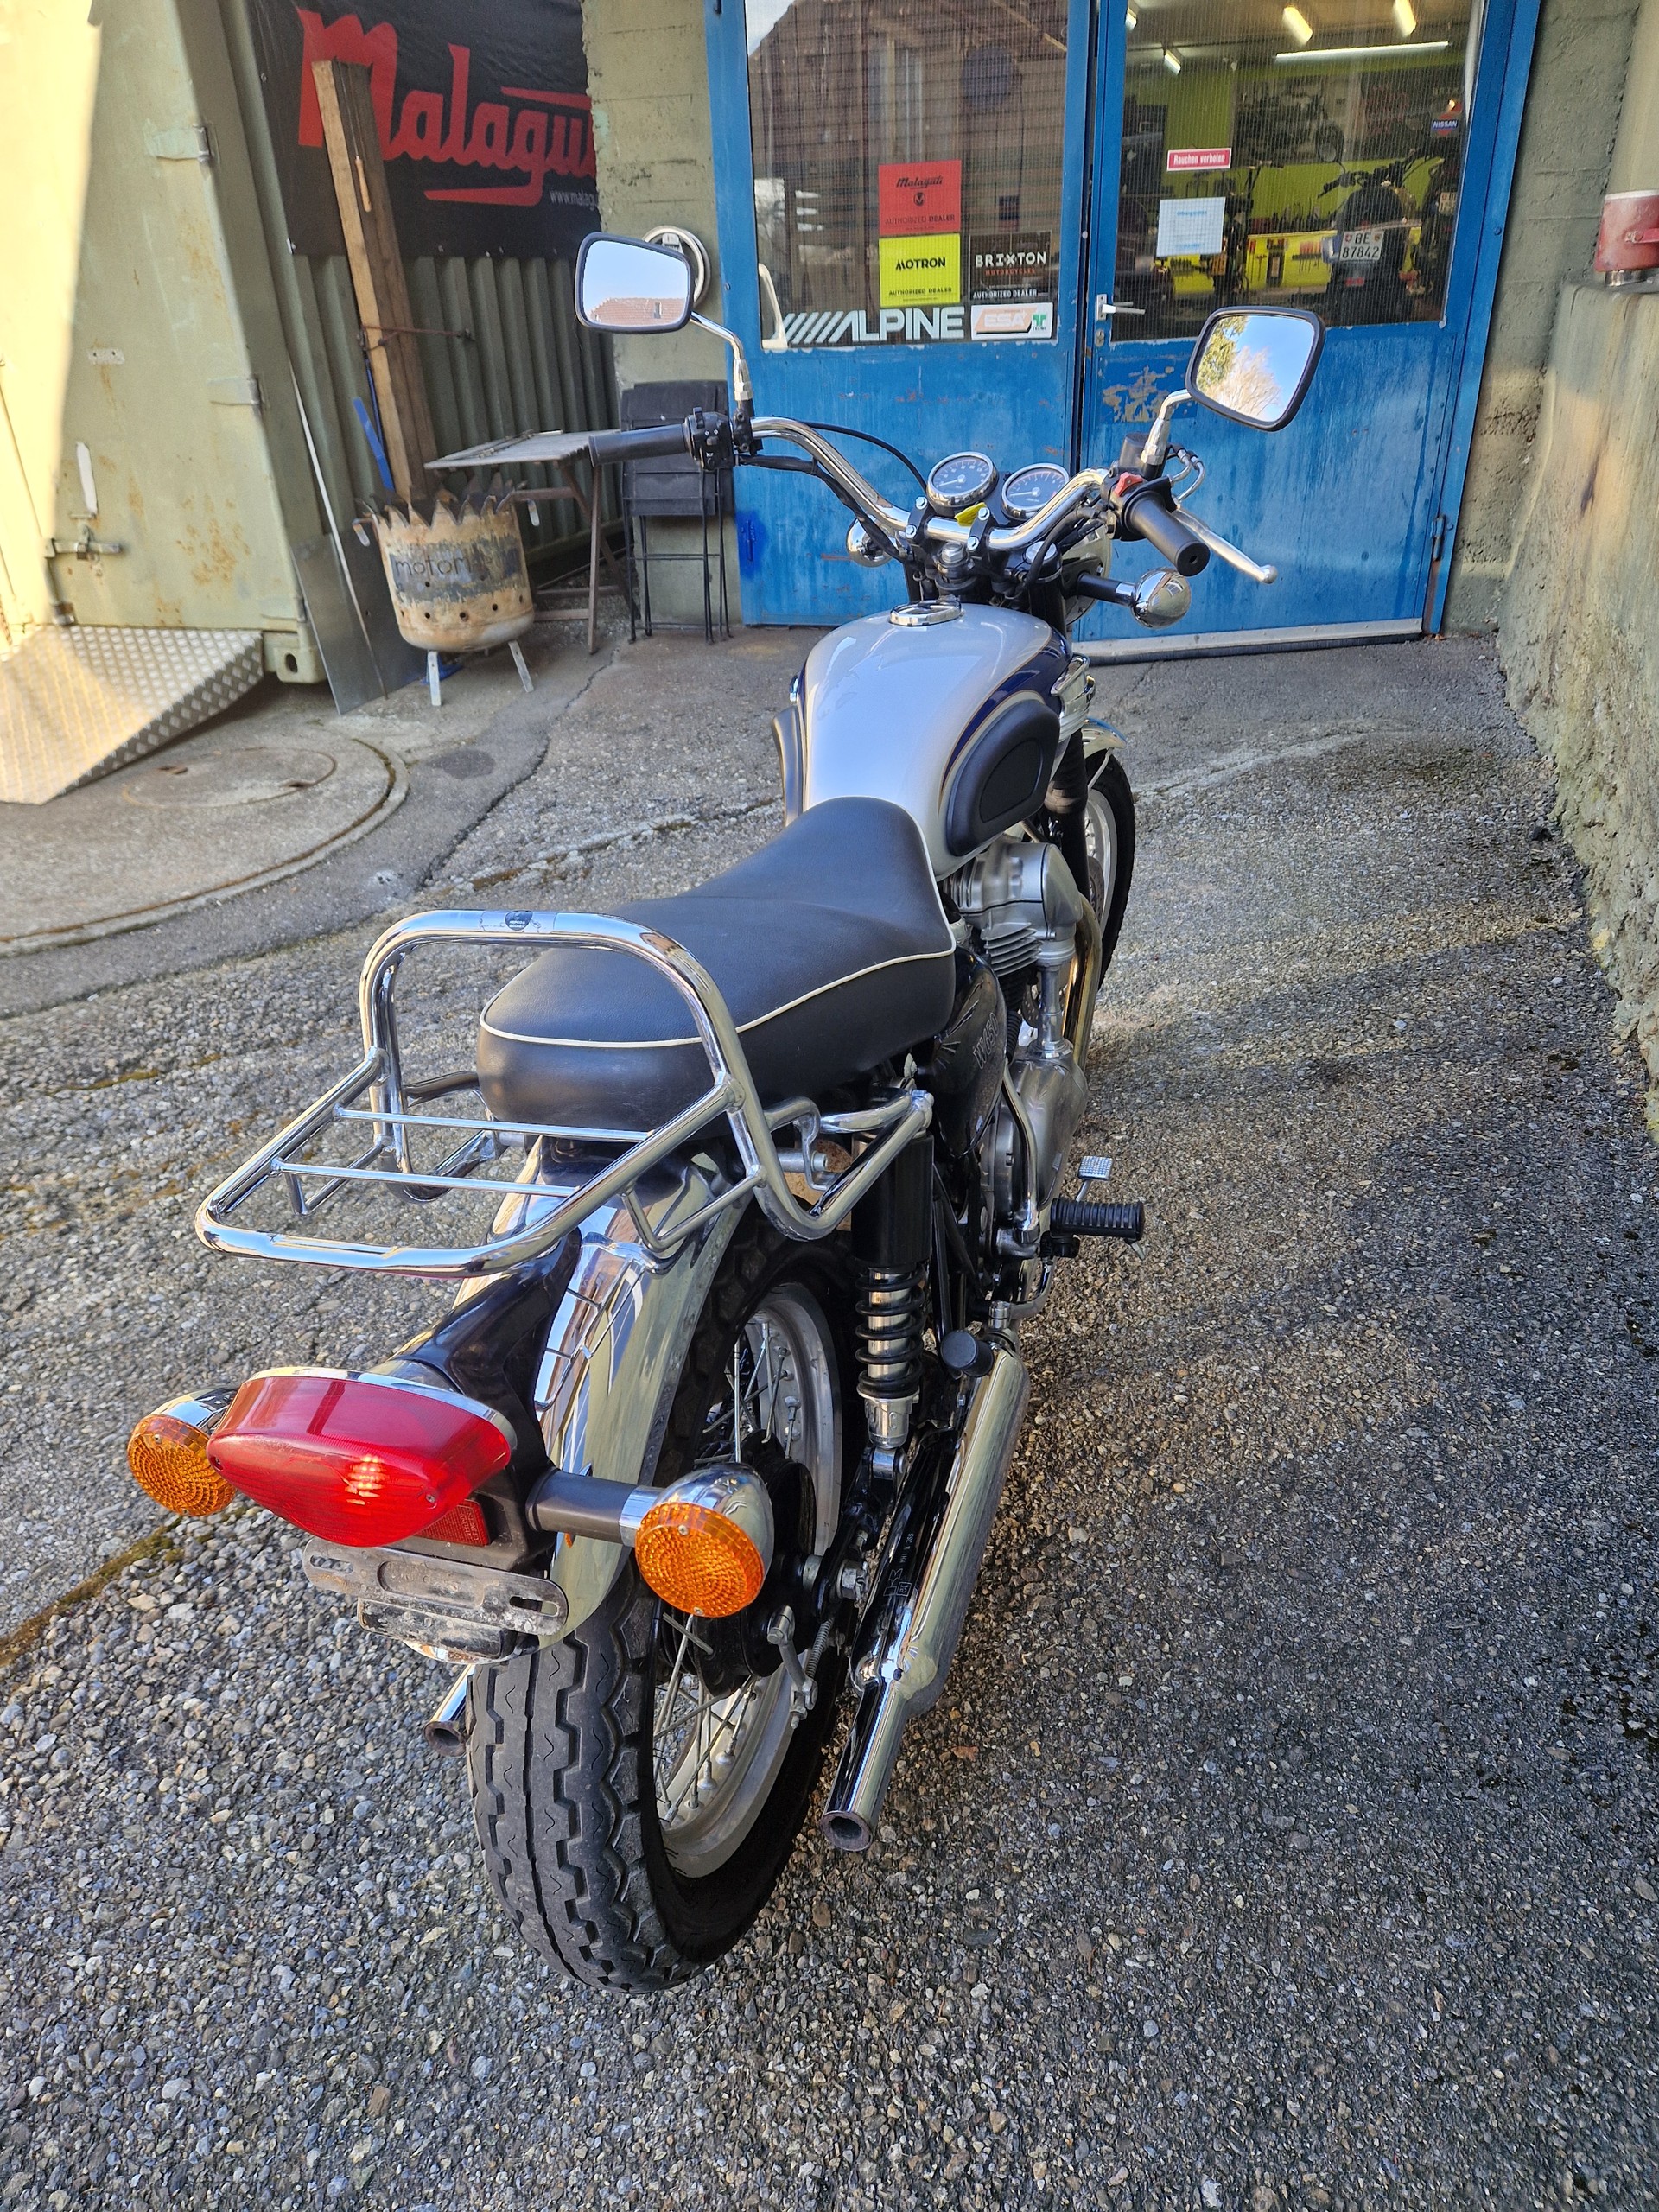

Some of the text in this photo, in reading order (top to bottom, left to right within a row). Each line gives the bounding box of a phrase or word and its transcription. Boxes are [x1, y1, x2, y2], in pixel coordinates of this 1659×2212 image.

[297, 8, 598, 206] Malagu
[1173, 152, 1225, 165] Rauchen verboten
[896, 175, 944, 189] Malaguti
[885, 215, 927, 225] AUTHORIZED
[1355, 232, 1371, 244] BE
[1342, 246, 1380, 258] 87842
[895, 257, 946, 271] MOTRON
[975, 251, 1046, 268] BRIXTON
[985, 267, 1036, 276] MOTORCYCLES
[972, 289, 1038, 300] AUTHORIZED DEALER
[827, 306, 965, 343] ALPINE
